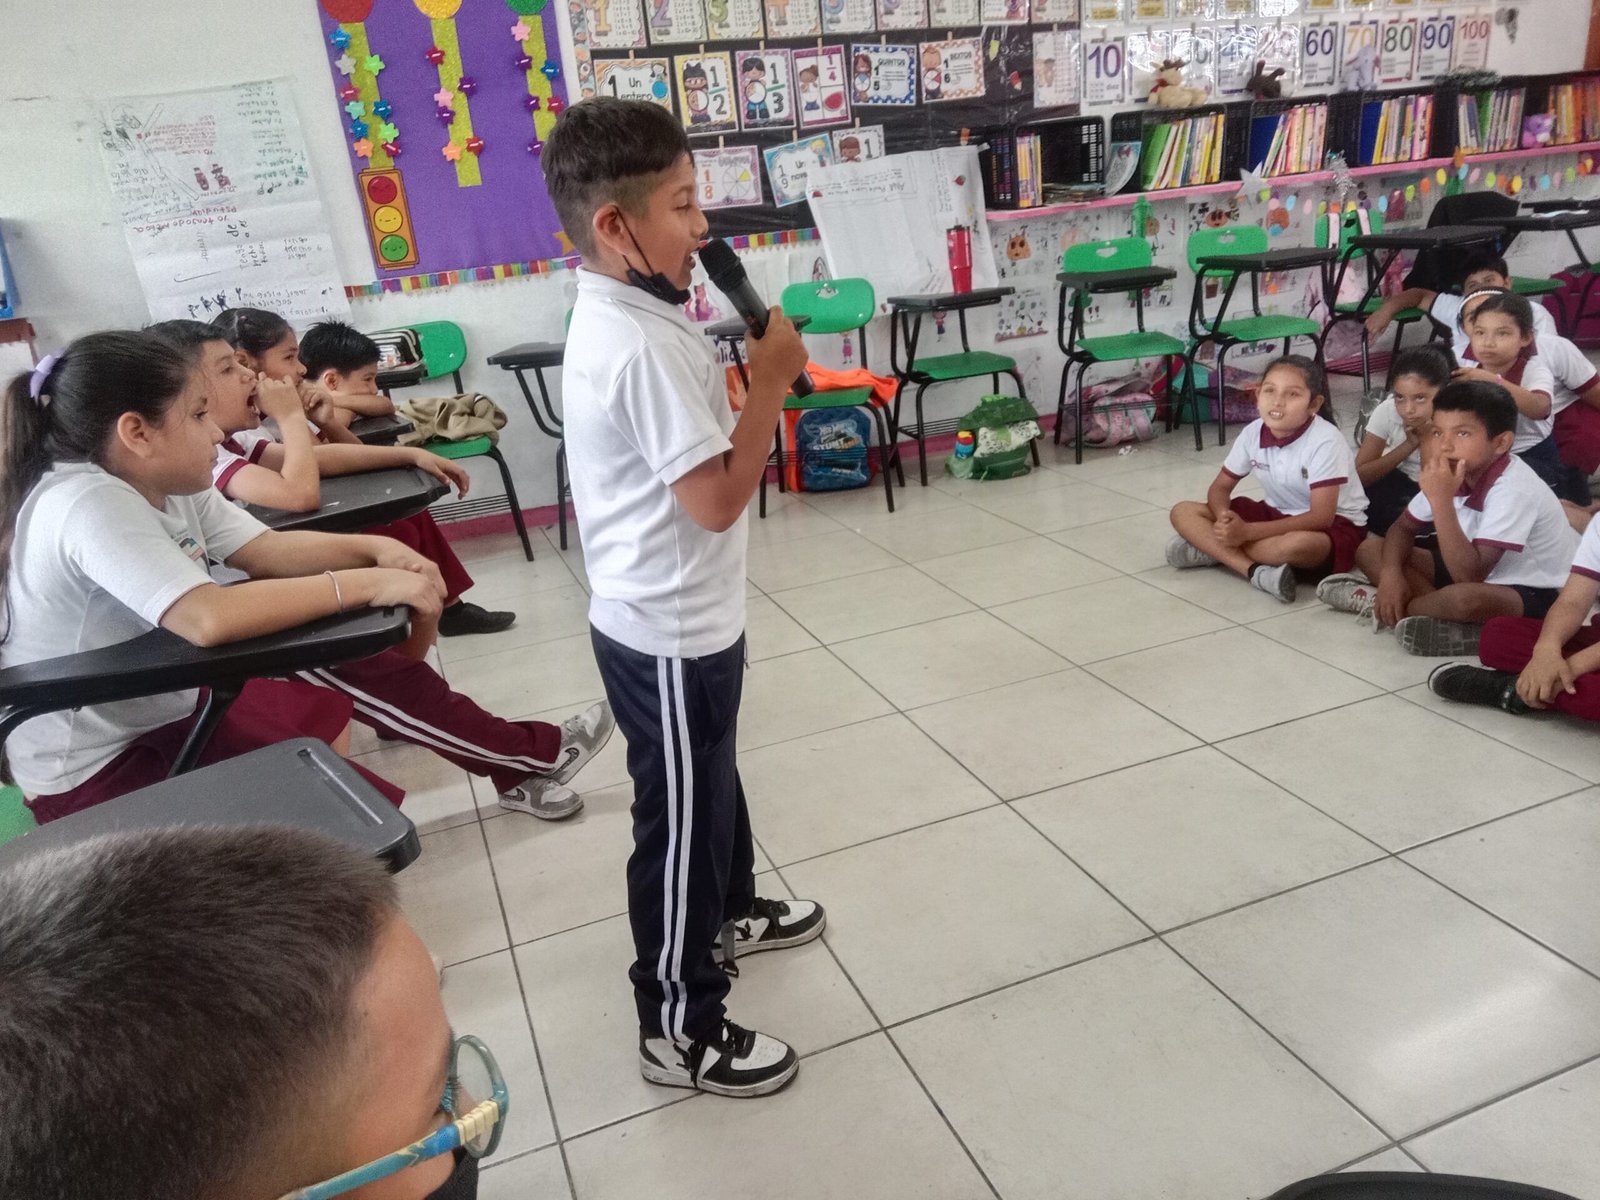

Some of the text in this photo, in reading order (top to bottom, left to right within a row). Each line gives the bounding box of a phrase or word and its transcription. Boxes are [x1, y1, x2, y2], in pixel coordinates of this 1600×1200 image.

[1423, 23, 1451, 50] 90
[1460, 20, 1489, 40] 100
[1305, 29, 1334, 57] 60
[1384, 25, 1413, 52] 80
[826, 54, 834, 66] 1
[944, 58, 950, 68] 1
[1088, 44, 1122, 79] 10
[710, 65, 720, 88] 1
[770, 62, 780, 85] 1
[828, 70, 837, 82] 4
[874, 66, 880, 76] 1
[944, 73, 951, 84] 6
[608, 74, 642, 100] 1 Un
[874, 80, 880, 91] 5
[620, 91, 654, 101] entero
[773, 92, 785, 114] 3
[712, 94, 728, 116] 2
[704, 170, 711, 182] 1
[778, 165, 786, 177] 1
[781, 178, 789, 190] 9
[704, 185, 714, 201] 8
